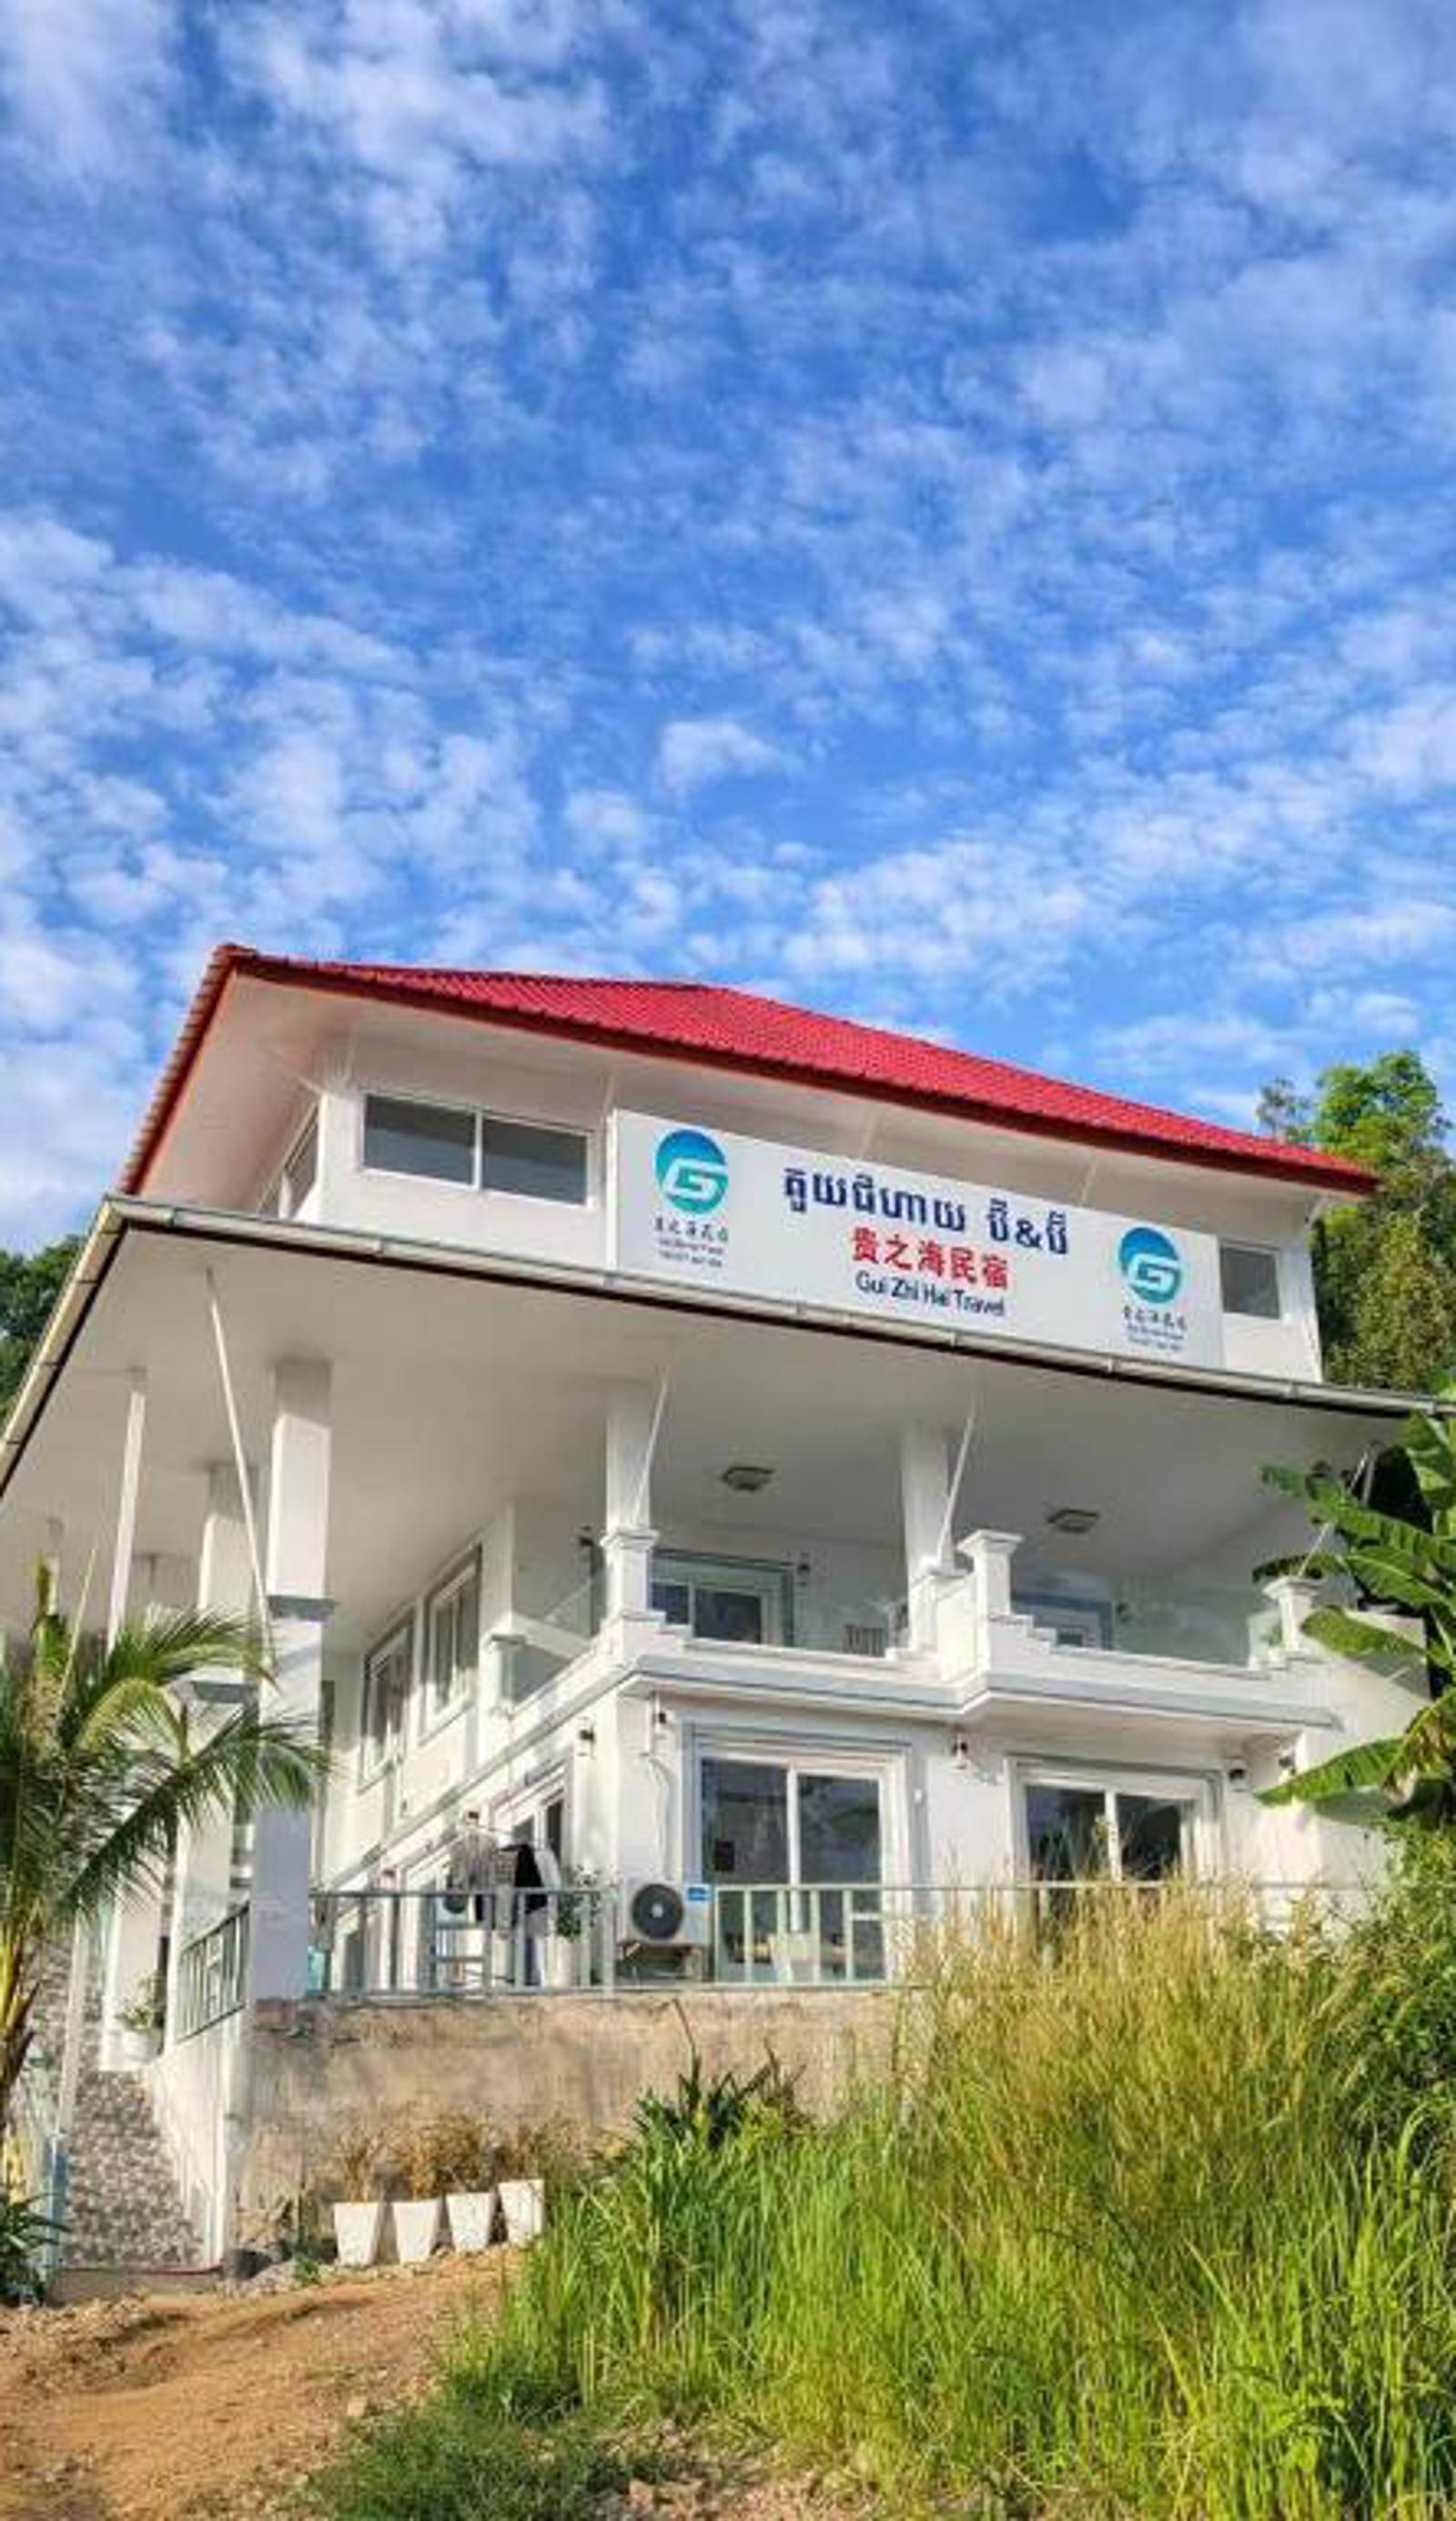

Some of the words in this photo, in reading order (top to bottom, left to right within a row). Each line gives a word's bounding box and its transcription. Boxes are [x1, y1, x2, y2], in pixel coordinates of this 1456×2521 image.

[855, 1270, 886, 1295] Gui
[891, 1276, 919, 1301] Zhi
[924, 1282, 951, 1307] Hai
[953, 1289, 1005, 1317] Travel
